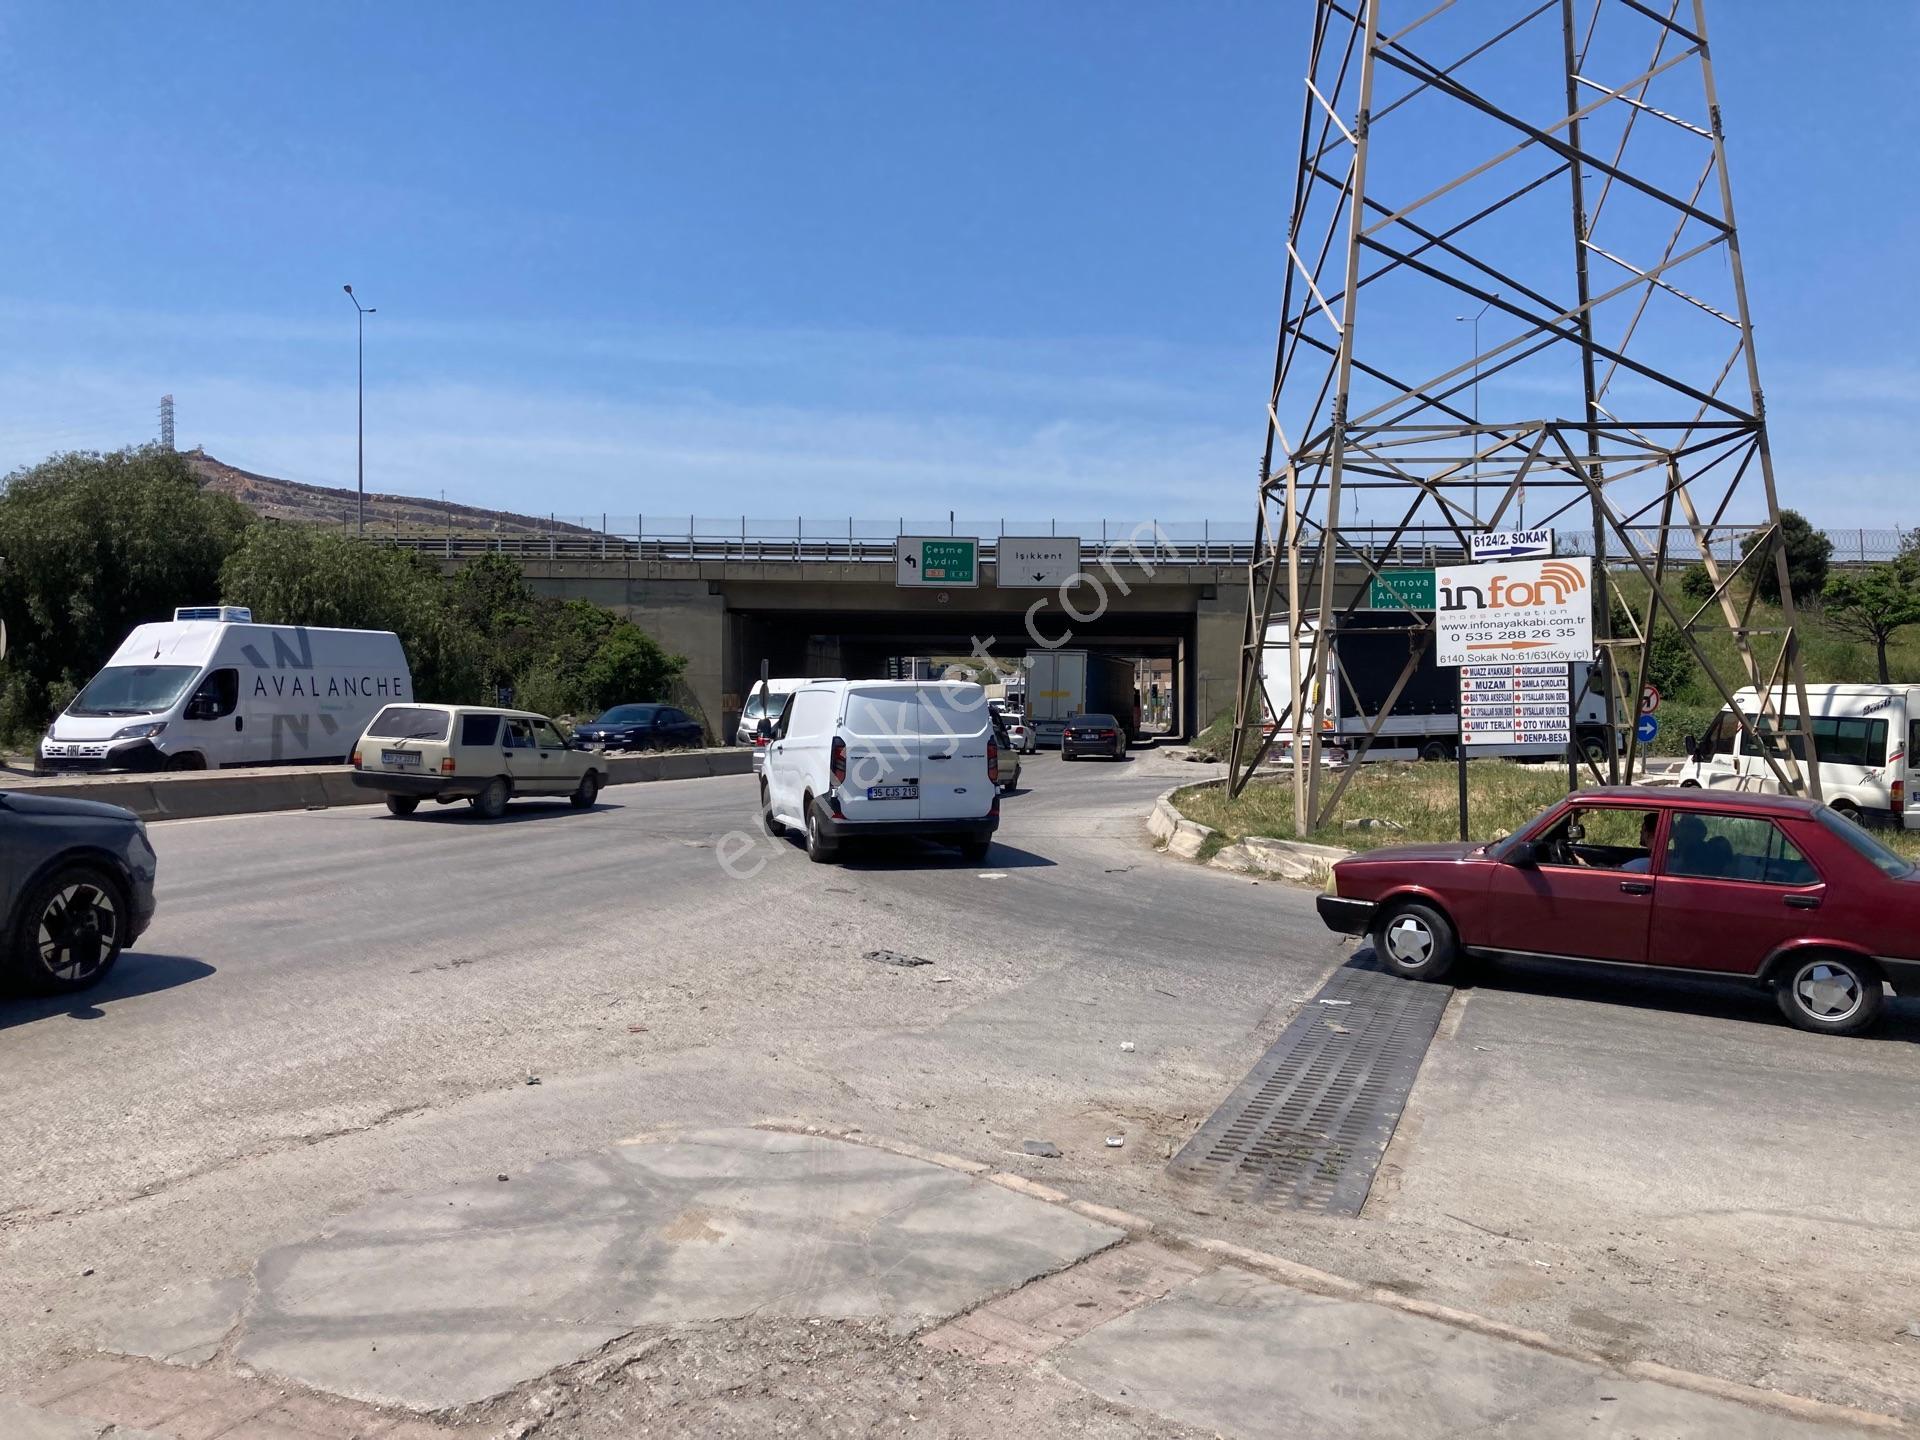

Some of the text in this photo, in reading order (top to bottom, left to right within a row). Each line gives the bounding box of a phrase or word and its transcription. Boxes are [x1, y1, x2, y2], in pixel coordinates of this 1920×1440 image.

[1474, 530, 1548, 548] 6124/2. SOKAK
[1377, 592, 1422, 600] Anara
[1440, 575, 1567, 611] infon
[1440, 609, 1568, 621] shoes creation
[1441, 616, 1585, 631] www.infonayakkabi.com.tr
[1465, 632, 1493, 641] 535
[1499, 630, 1526, 640] 288
[1532, 629, 1551, 638] 26
[1556, 628, 1575, 637] 35
[1440, 654, 1465, 664] 6140
[1467, 653, 1498, 662] Sokak
[254, 675, 402, 697] AVALANCHE
[1475, 680, 1506, 689] MUZAM
[1522, 680, 1539, 688] DAMLA
[1471, 719, 1512, 730] UMUT TERLİK
[1523, 719, 1567, 729] OTO YIKAMA
[1523, 733, 1568, 742] DENPA-BESA
[66, 744, 81, 757] FIAT
[873, 787, 917, 797] 35 CJS 219
